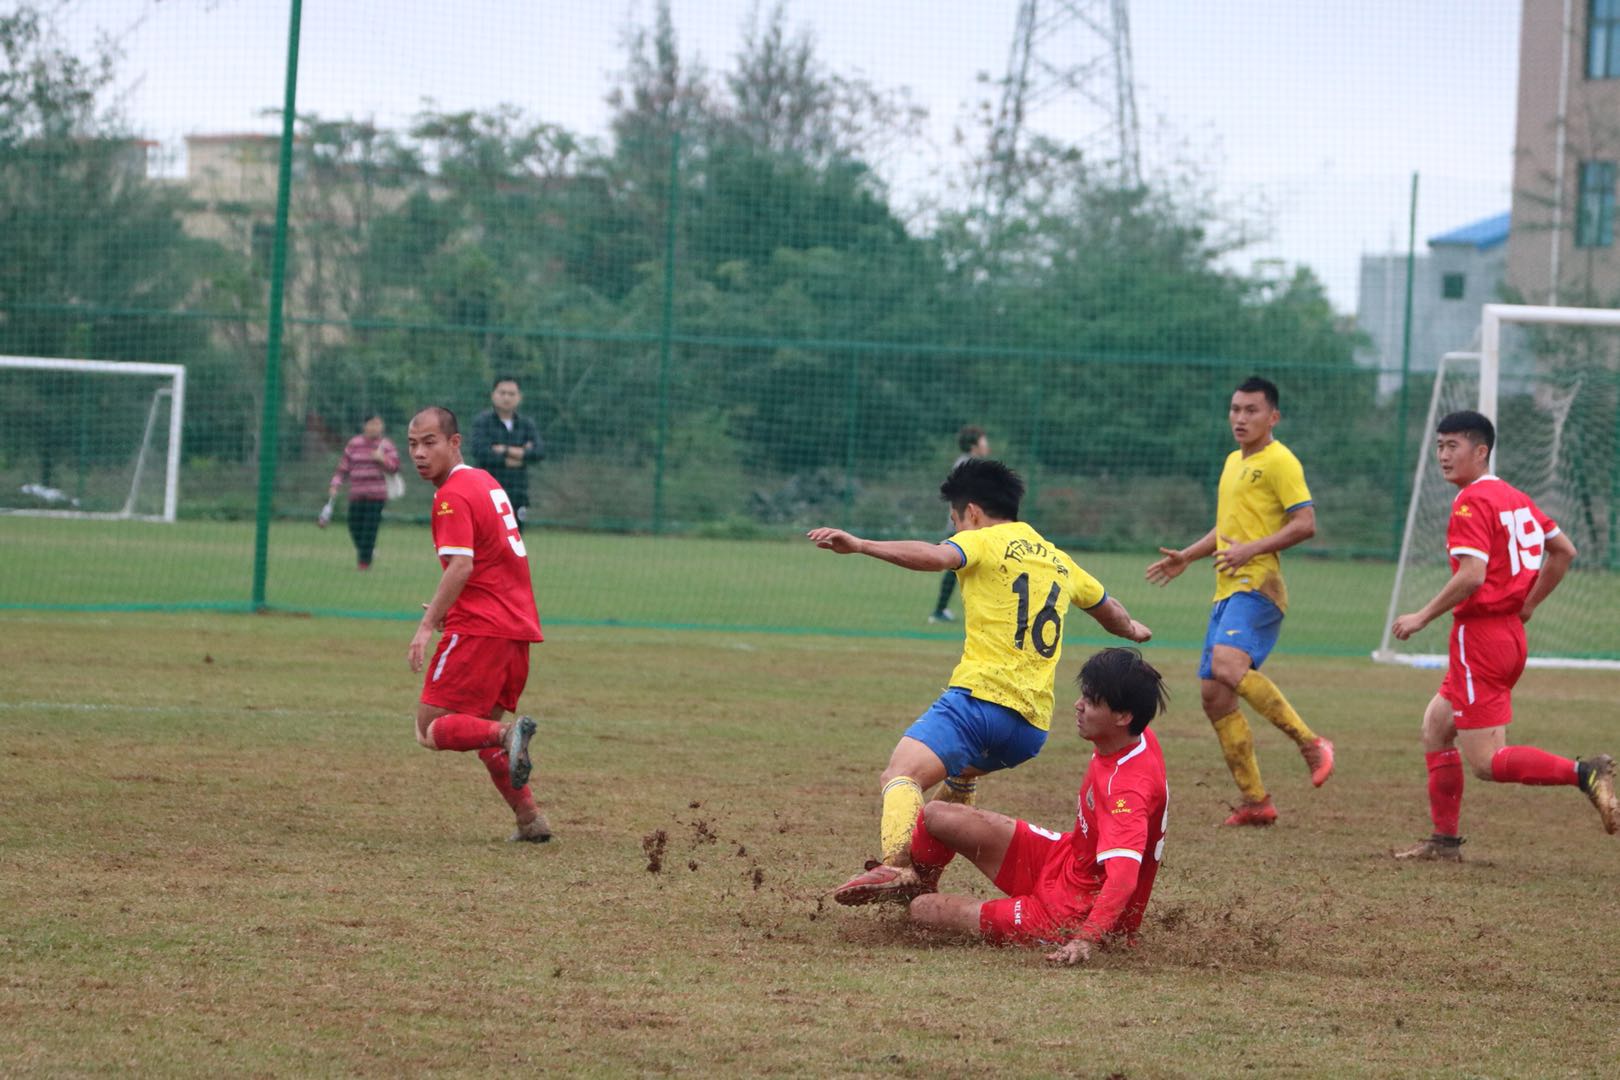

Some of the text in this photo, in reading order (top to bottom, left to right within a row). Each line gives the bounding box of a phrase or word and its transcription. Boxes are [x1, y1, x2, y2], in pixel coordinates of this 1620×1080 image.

[1499, 506, 1545, 577] 19
[1012, 571, 1061, 659] 16
[1111, 805, 1133, 815] KELME
